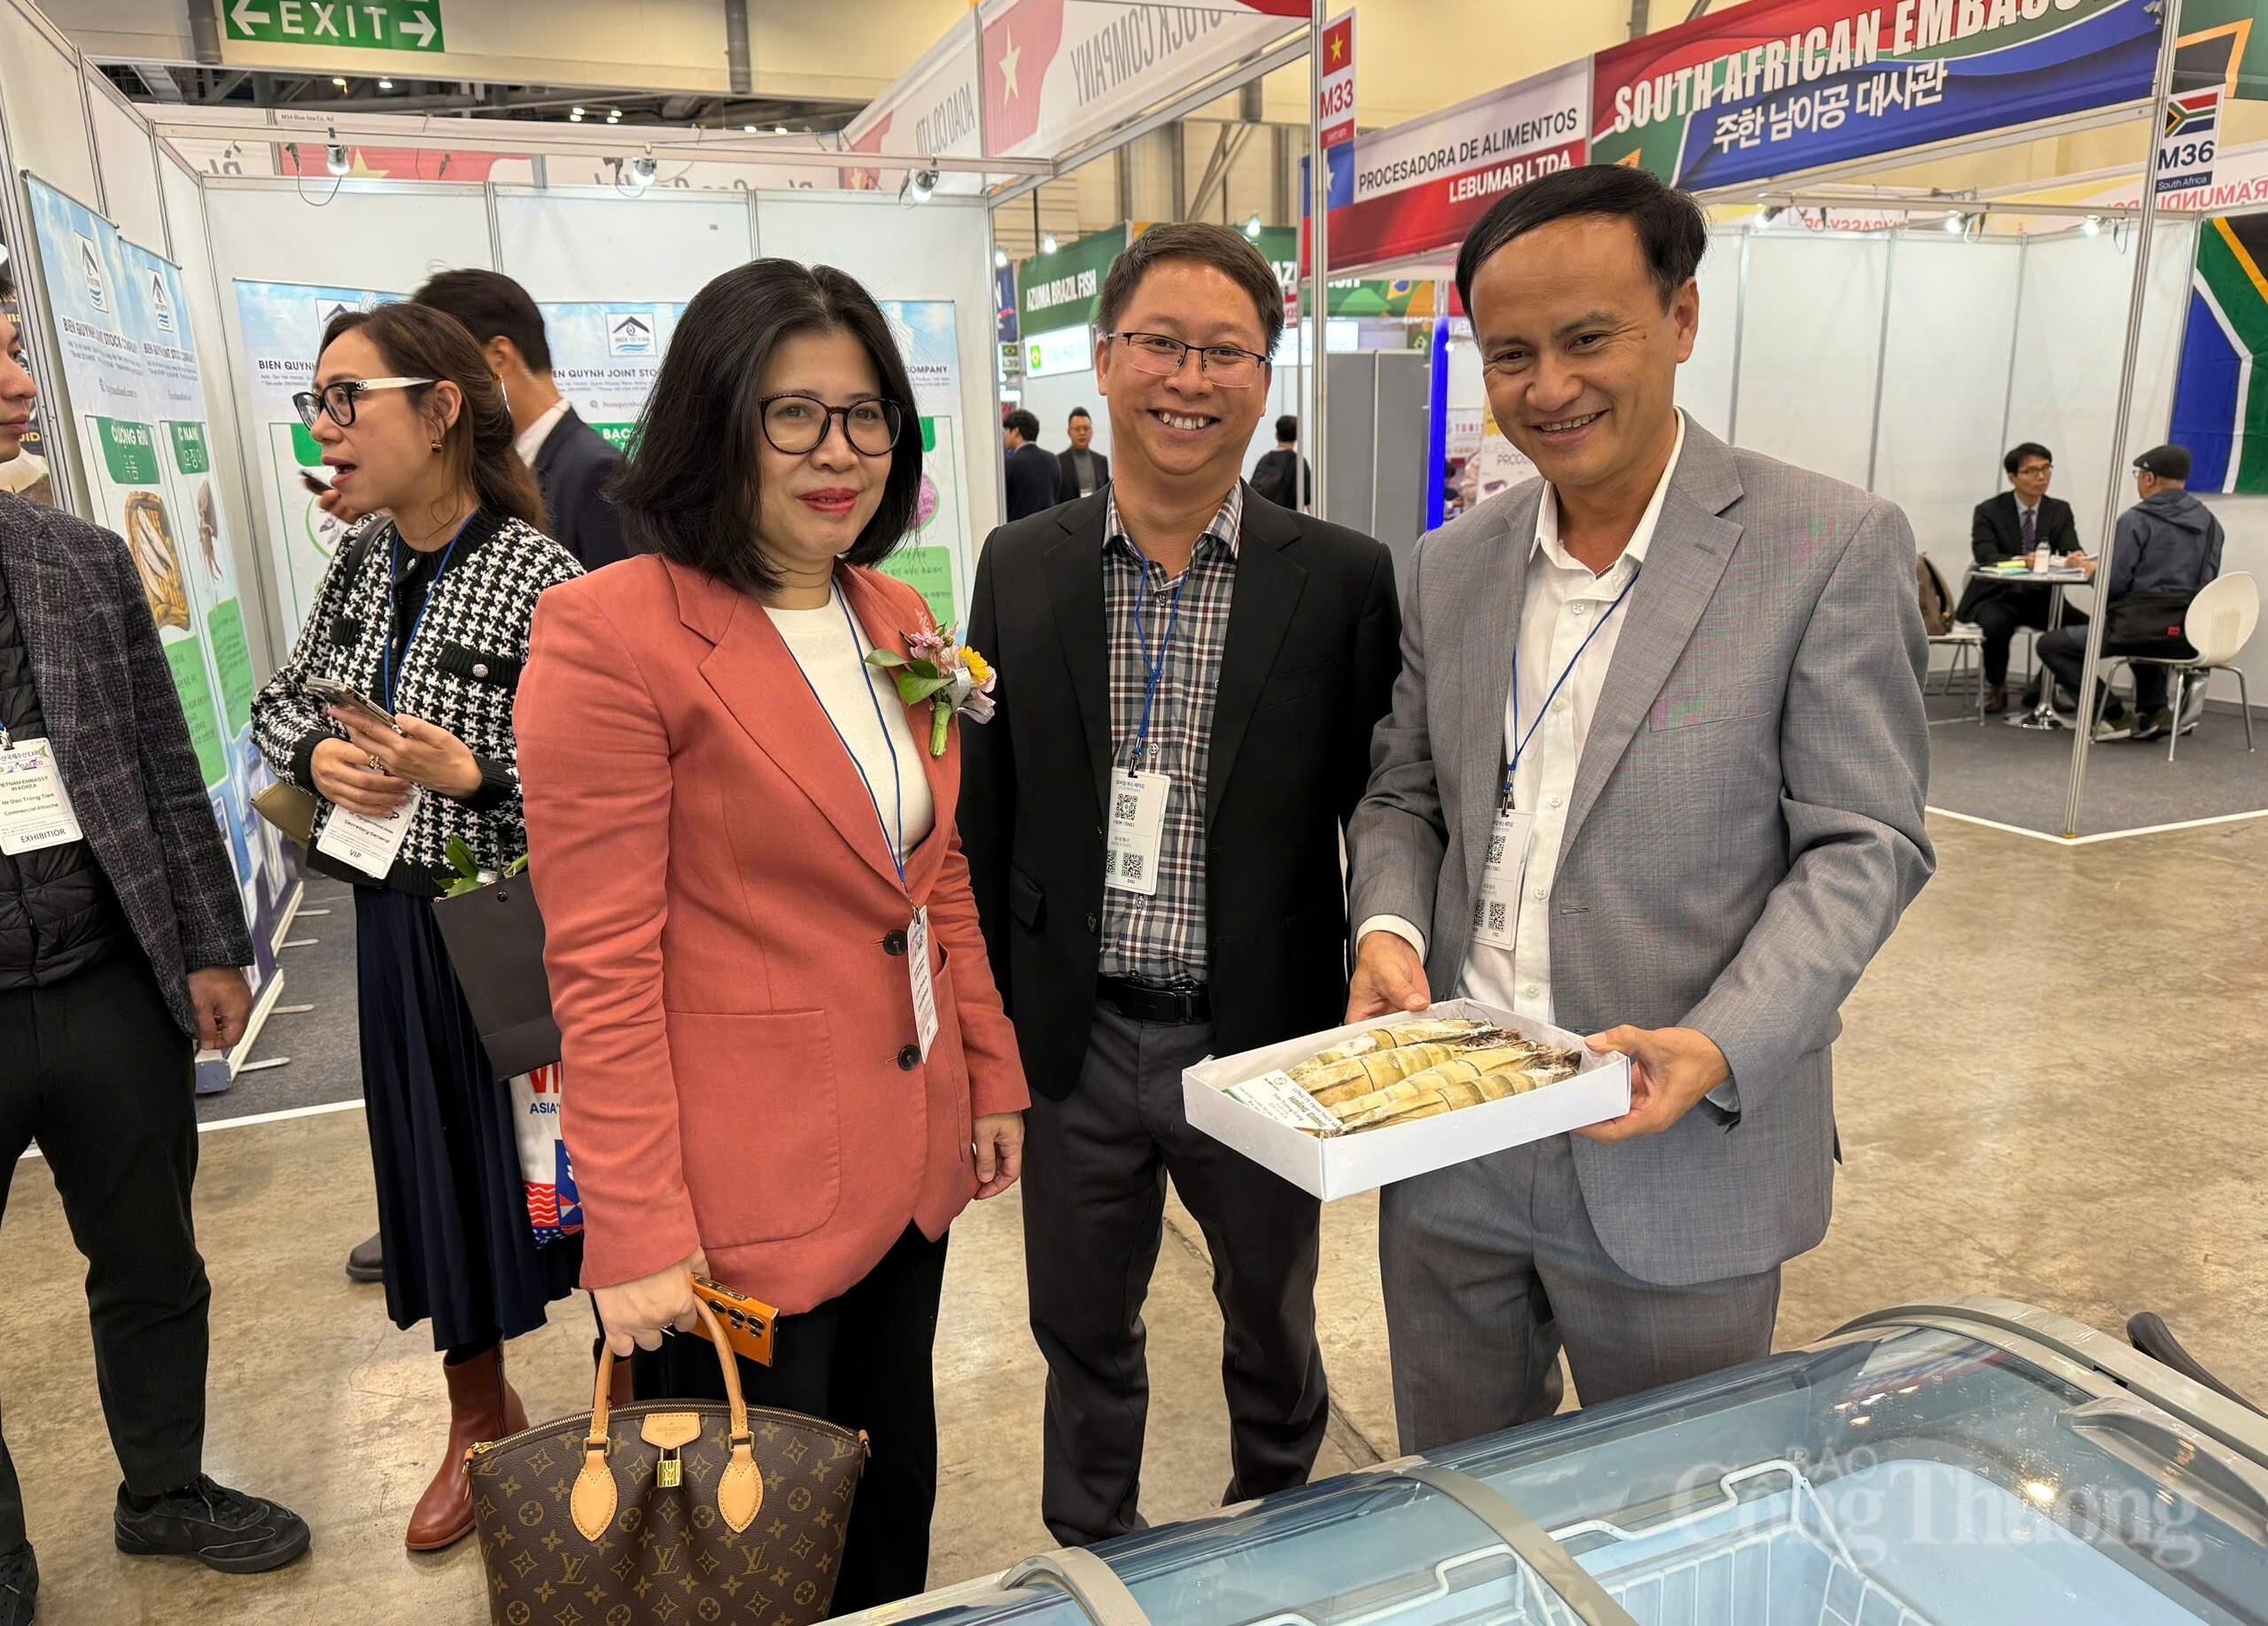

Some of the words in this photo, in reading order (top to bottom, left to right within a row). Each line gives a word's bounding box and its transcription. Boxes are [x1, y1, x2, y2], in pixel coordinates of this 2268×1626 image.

[278, 1, 388, 40] EXIT
[1613, 59, 1714, 134] SOUTH
[1720, 9, 1884, 106] AFRICAN
[1319, 78, 1354, 120] M33
[1713, 107, 1765, 154] 주한
[1769, 82, 1850, 140] 남아공
[1856, 58, 1948, 118] 대사관
[1358, 145, 1456, 193] PROCESADORA
[1460, 138, 1479, 162] DE
[1481, 107, 1578, 155] ALIMENTOS
[2158, 140, 2215, 171] M36
[1449, 167, 1524, 204] LEBUMAR
[2158, 178, 2182, 191] South
[2182, 175, 2207, 188] Africa
[259, 360, 281, 370] BIEN
[553, 370, 565, 378] EN
[569, 370, 603, 378] QUYNH
[607, 370, 635, 378] JOINT
[639, 369, 656, 377] STO
[349, 849, 361, 860] VIP
[530, 1102, 560, 1115] ASIA'
